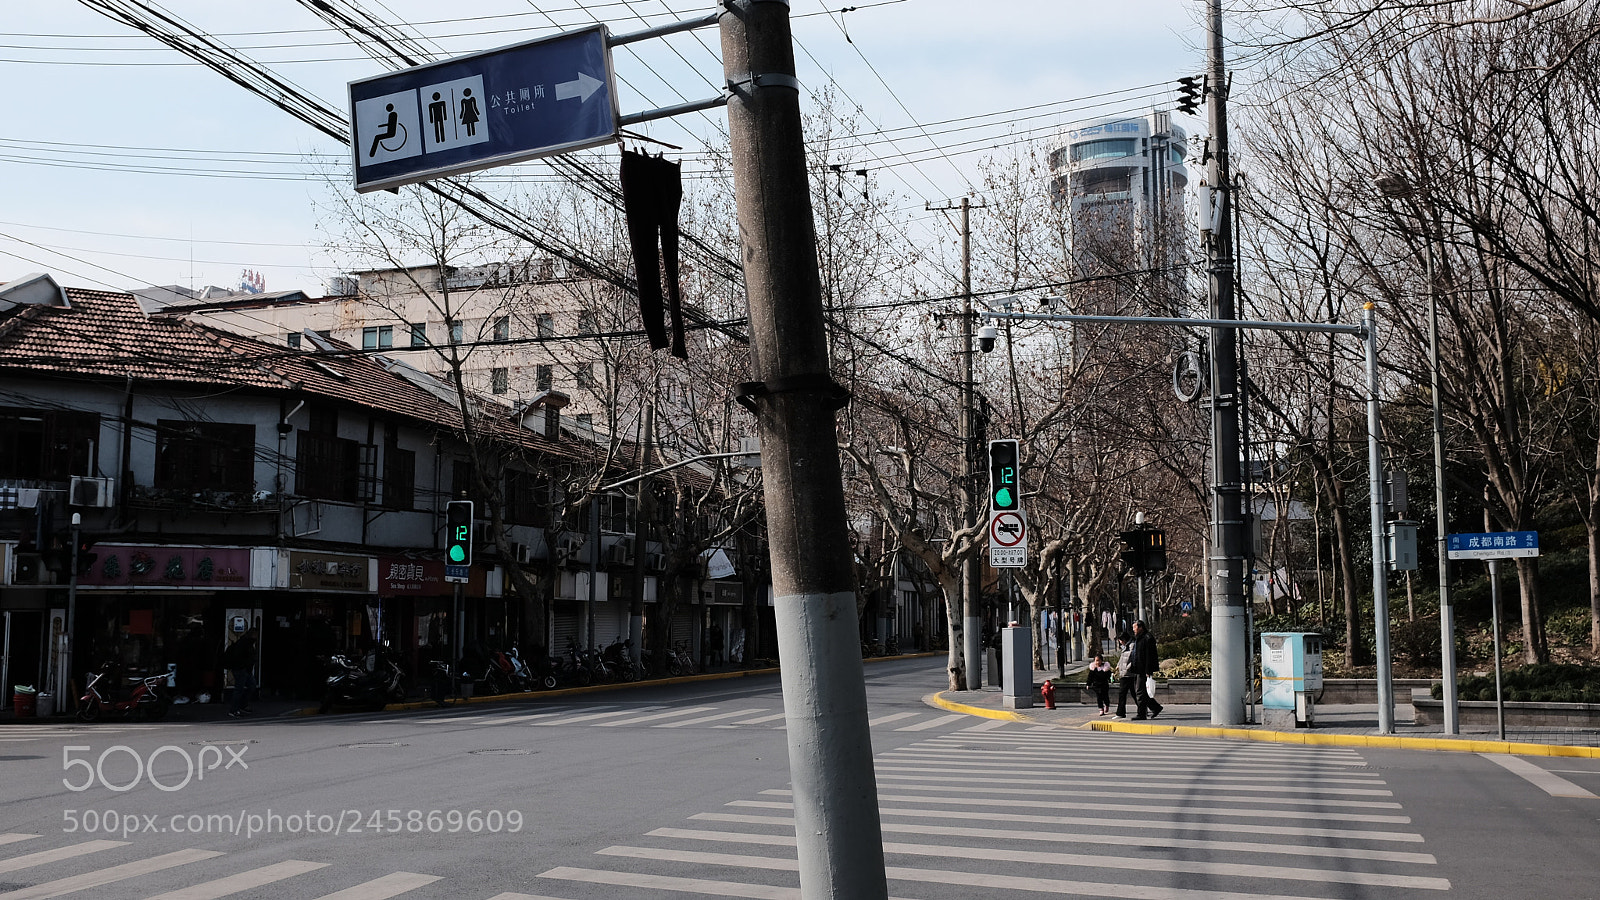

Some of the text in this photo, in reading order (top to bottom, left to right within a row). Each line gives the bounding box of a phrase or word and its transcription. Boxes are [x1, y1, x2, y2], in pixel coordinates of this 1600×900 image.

[503, 102, 535, 115] Toilet
[1001, 467, 1014, 484] 12
[455, 525, 468, 541] 12
[1452, 536, 1460, 544] 南
[1468, 535, 1517, 548] 成都南路
